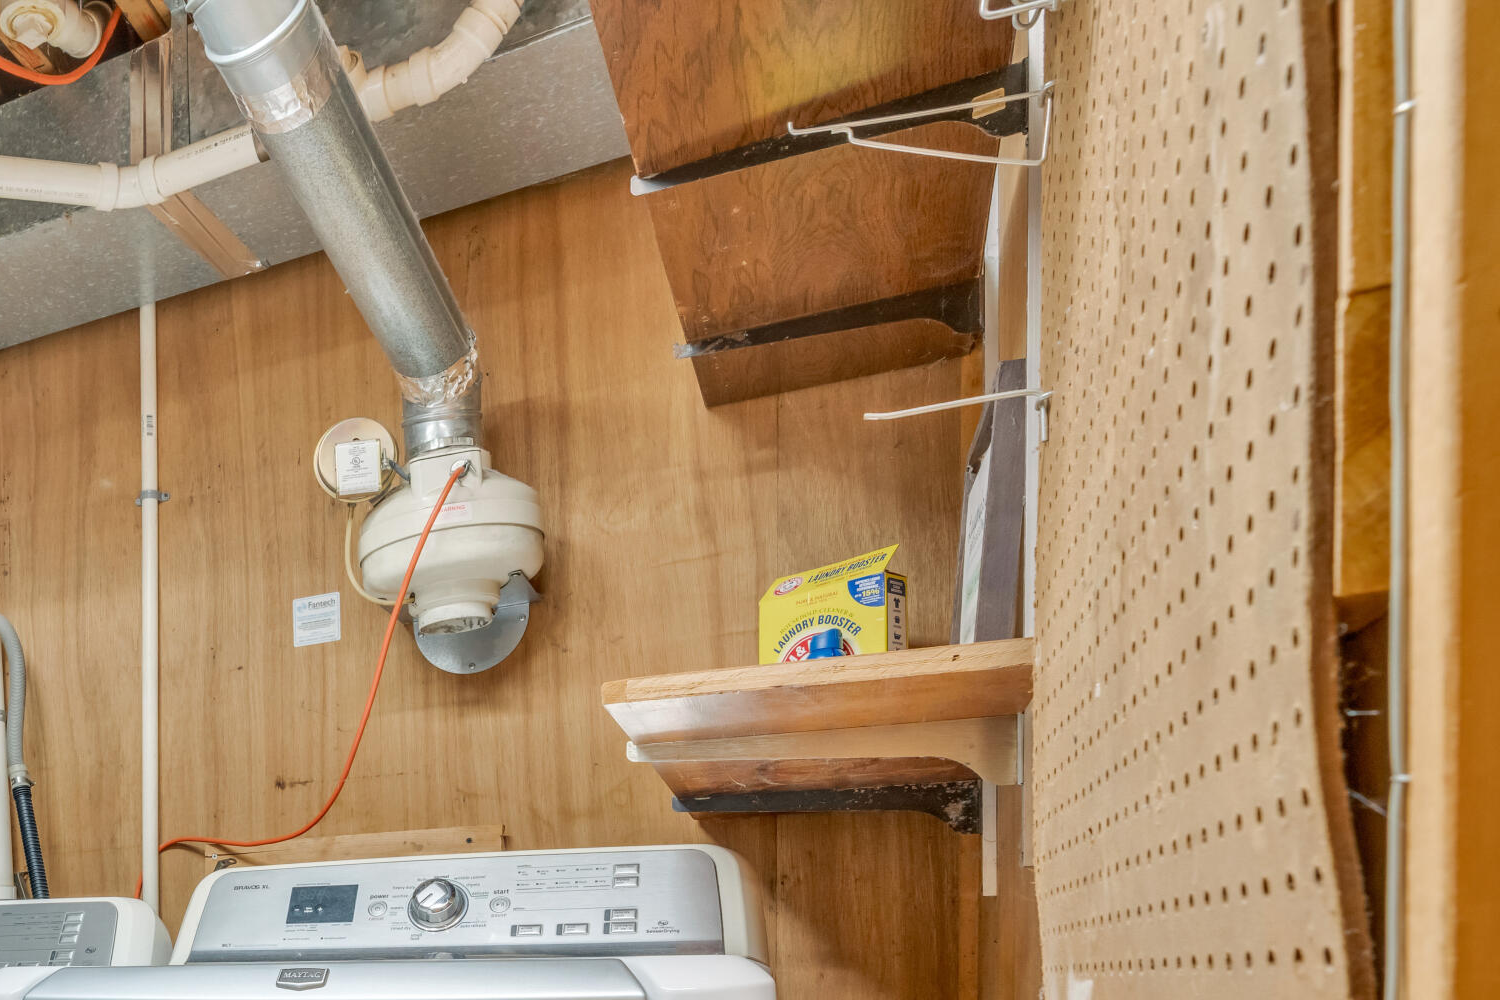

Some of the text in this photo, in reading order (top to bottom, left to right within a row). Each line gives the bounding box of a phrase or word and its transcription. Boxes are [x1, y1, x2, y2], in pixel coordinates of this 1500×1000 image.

[441, 504, 466, 513] ARNING
[808, 567, 846, 583] LAUNDRY
[846, 553, 887, 572] BOOSTER
[861, 588, 880, 597] 15%
[308, 599, 336, 609] Fantech
[773, 614, 862, 654] LAUNDRY BOOSTER
